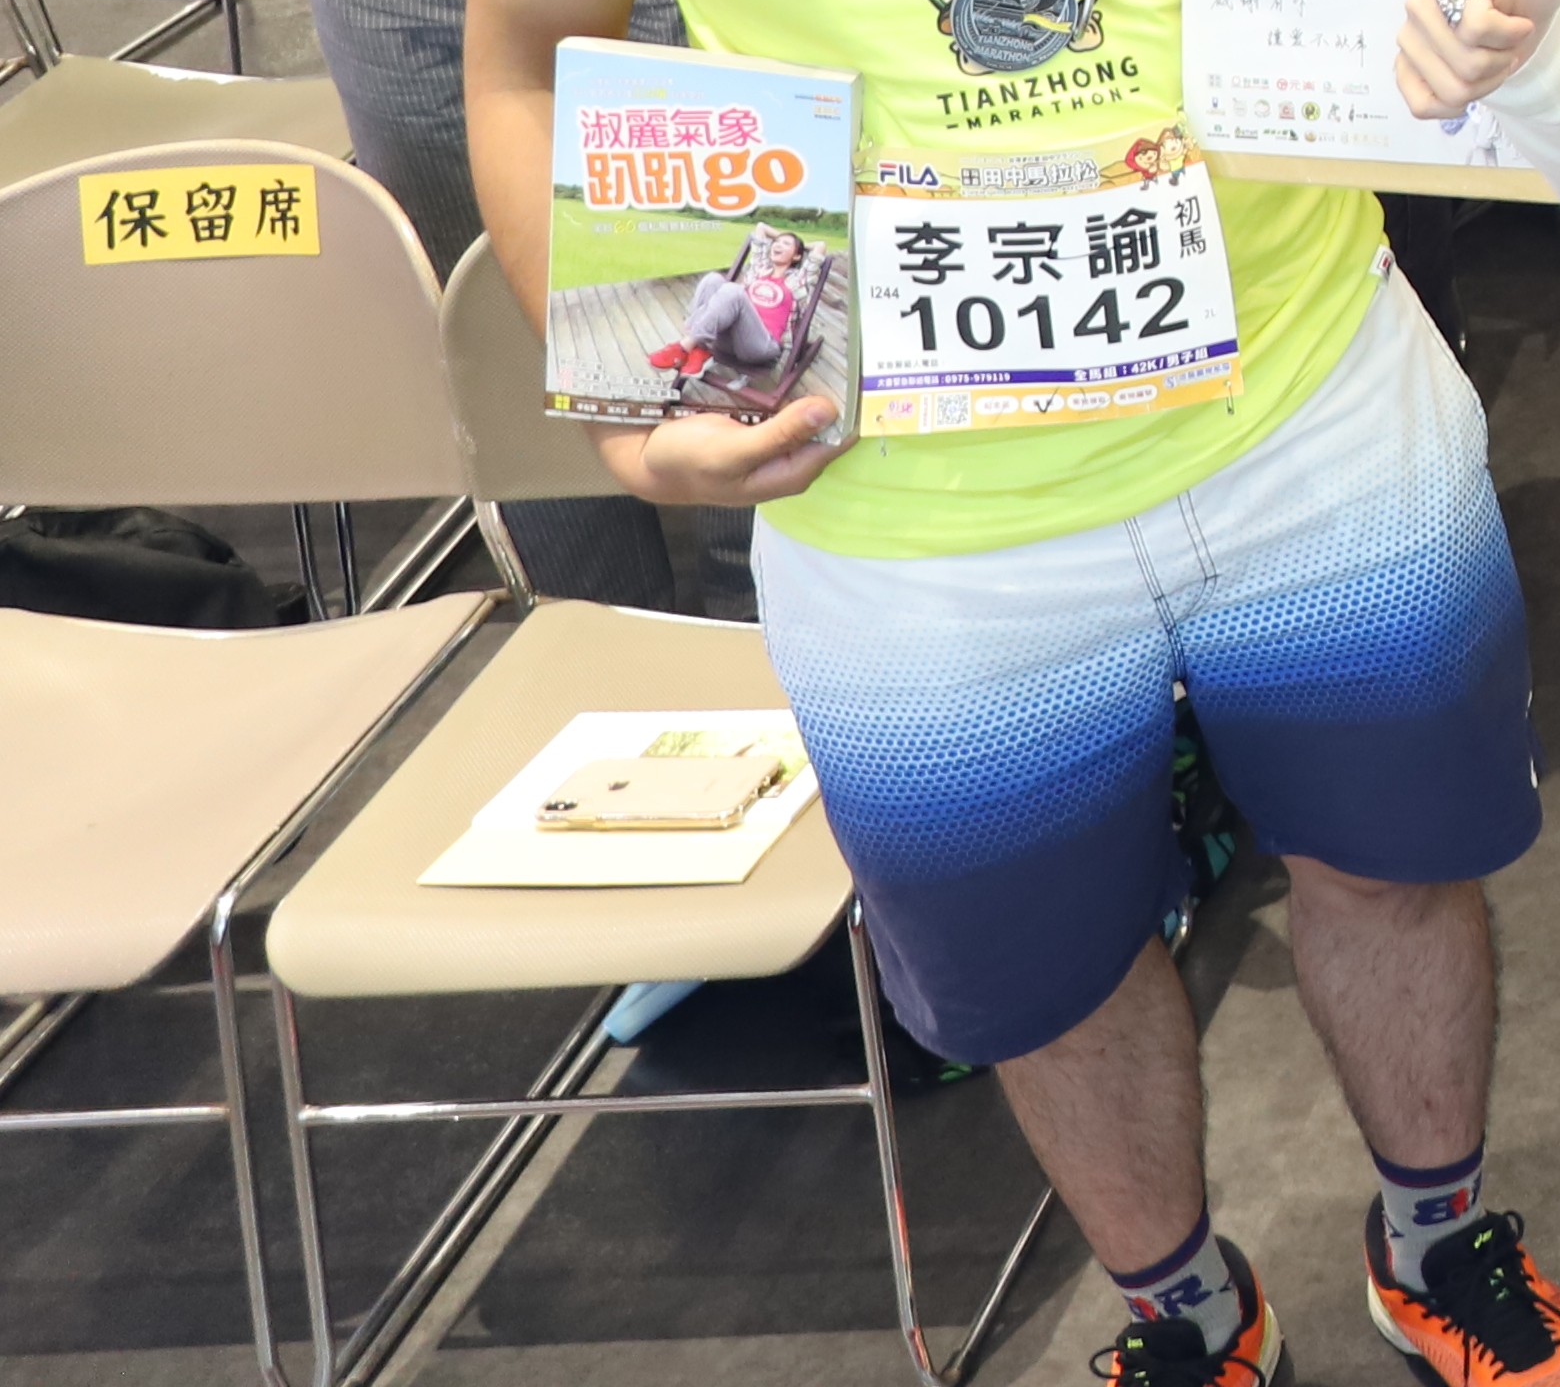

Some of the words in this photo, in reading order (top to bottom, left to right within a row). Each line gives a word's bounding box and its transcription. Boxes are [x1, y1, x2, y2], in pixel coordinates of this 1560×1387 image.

[937, 56, 1139, 116] TIANZHONG
[967, 87, 1122, 130] MARATHON
[581, 108, 763, 149] 淑麗氣象
[878, 163, 941, 186] FILA
[95, 178, 301, 250] 保留席
[1174, 195, 1206, 259] 初馬
[895, 207, 1161, 285] 李宗諭
[900, 277, 1189, 352] 10142
